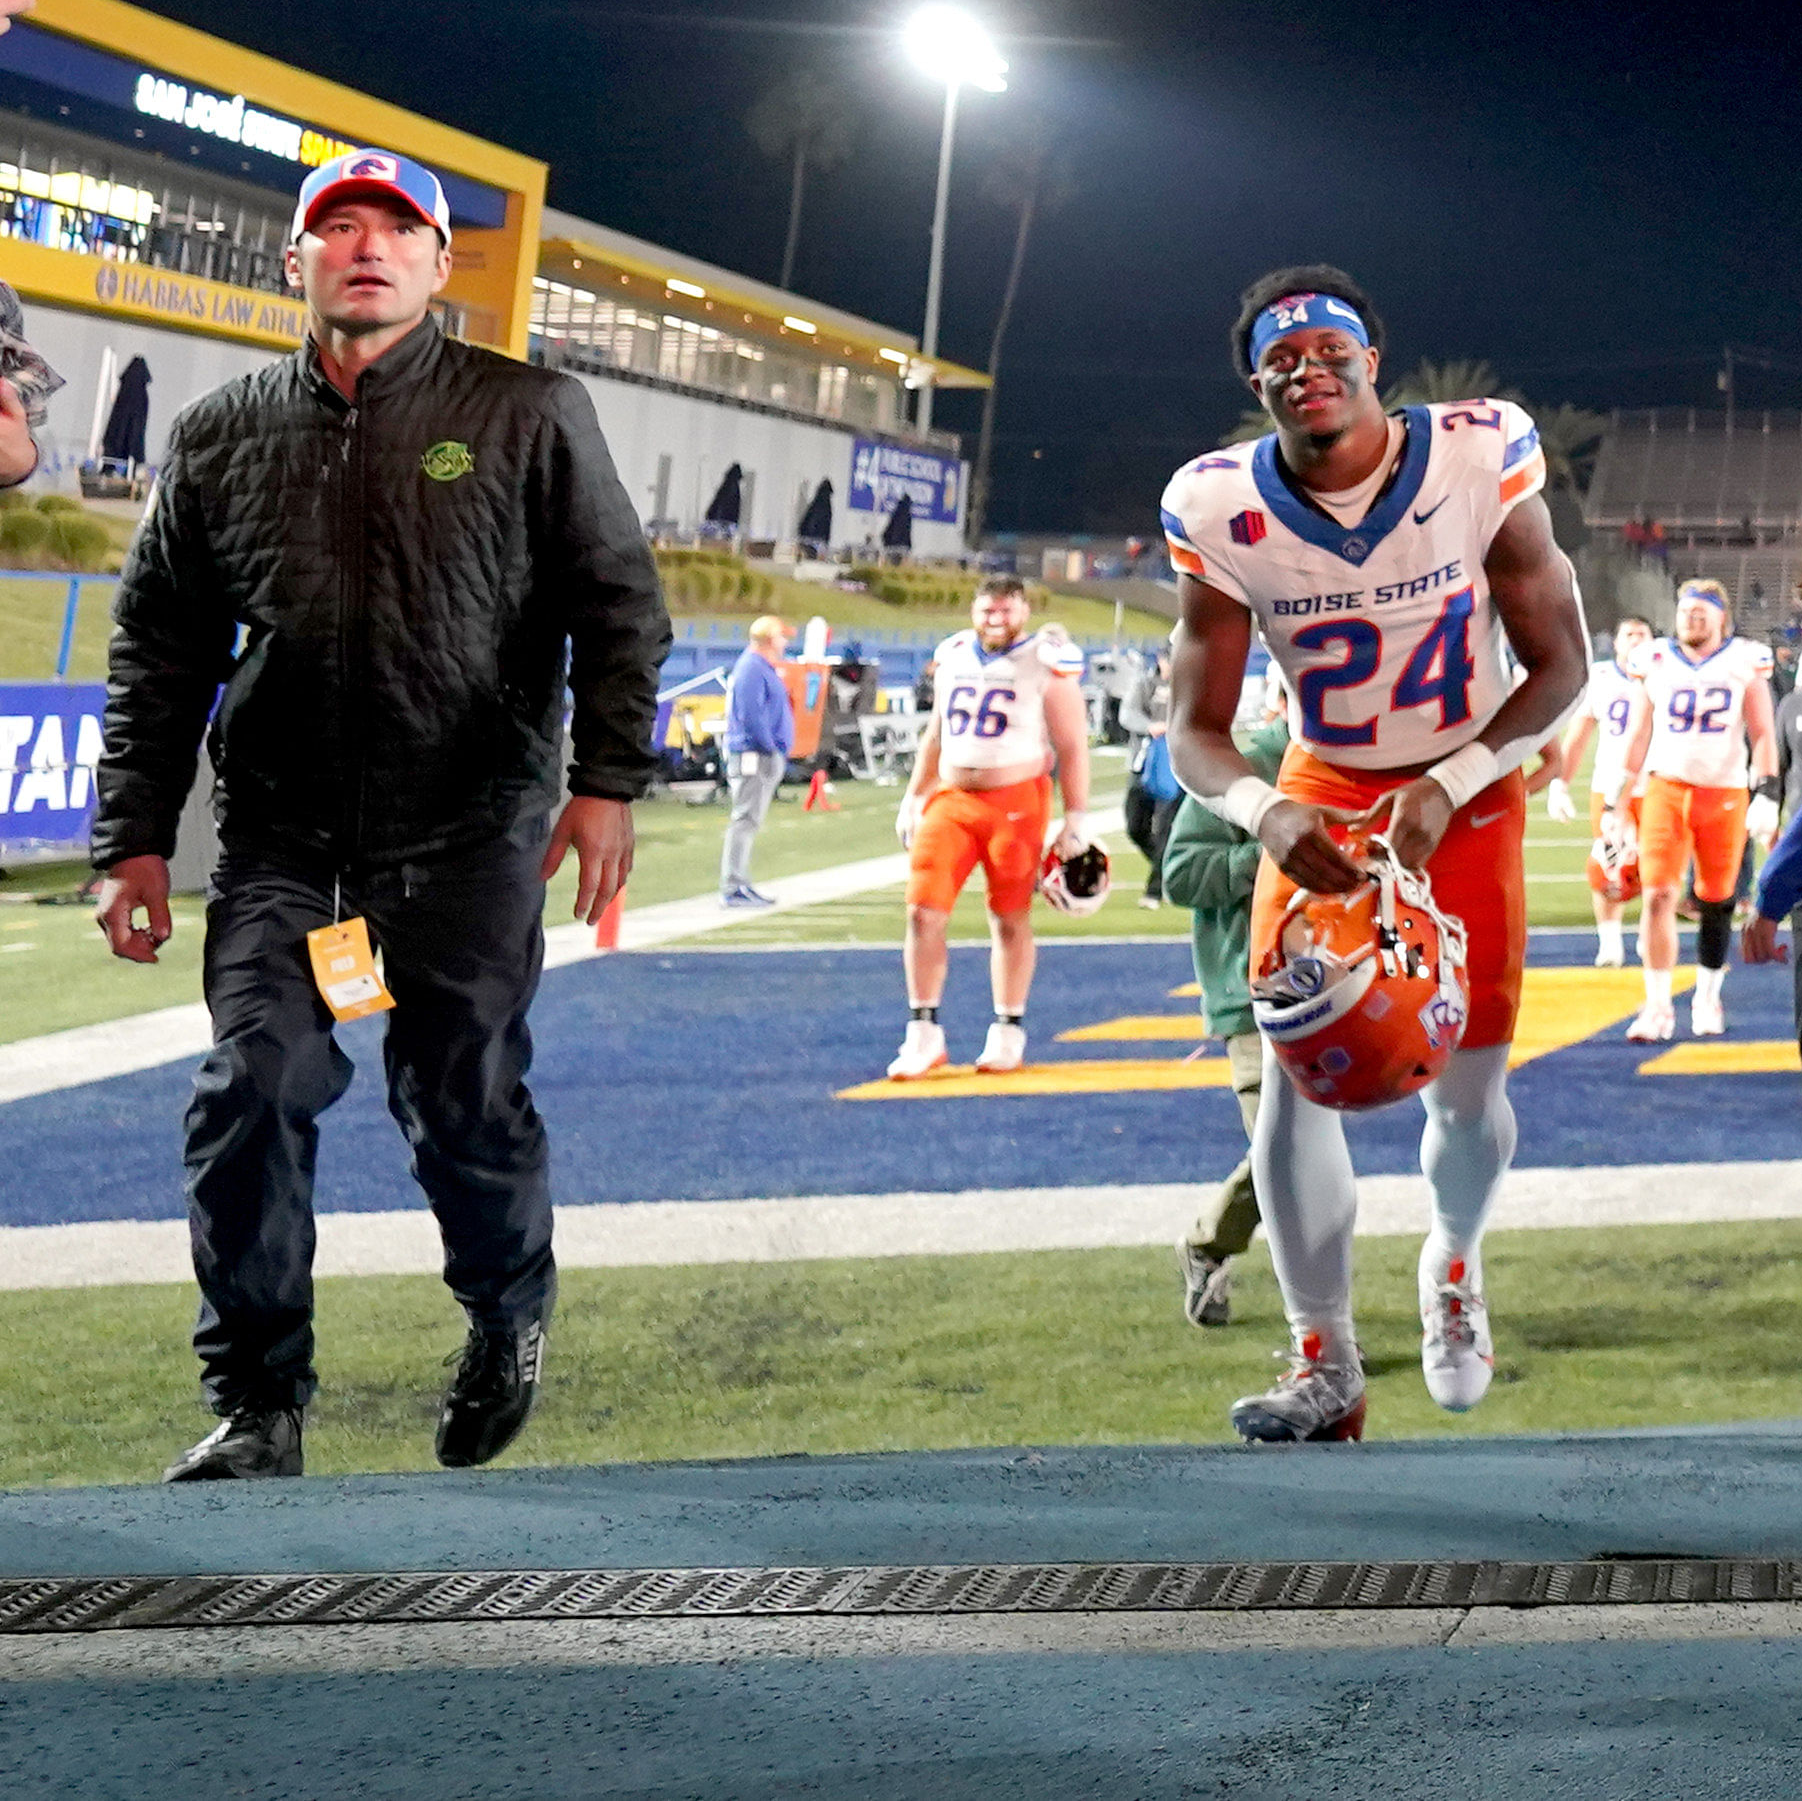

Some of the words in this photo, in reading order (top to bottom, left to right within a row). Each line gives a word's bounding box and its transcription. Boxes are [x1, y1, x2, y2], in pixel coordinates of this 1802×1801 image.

[135, 73, 187, 124] SAN
[123, 271, 205, 318] HABBAS
[212, 291, 254, 327] LAW
[1272, 590, 1365, 616] BOISE
[1373, 559, 1463, 605] STATE
[1290, 582, 1476, 747] 24
[946, 685, 1017, 739] 66
[1667, 687, 1733, 734] 92
